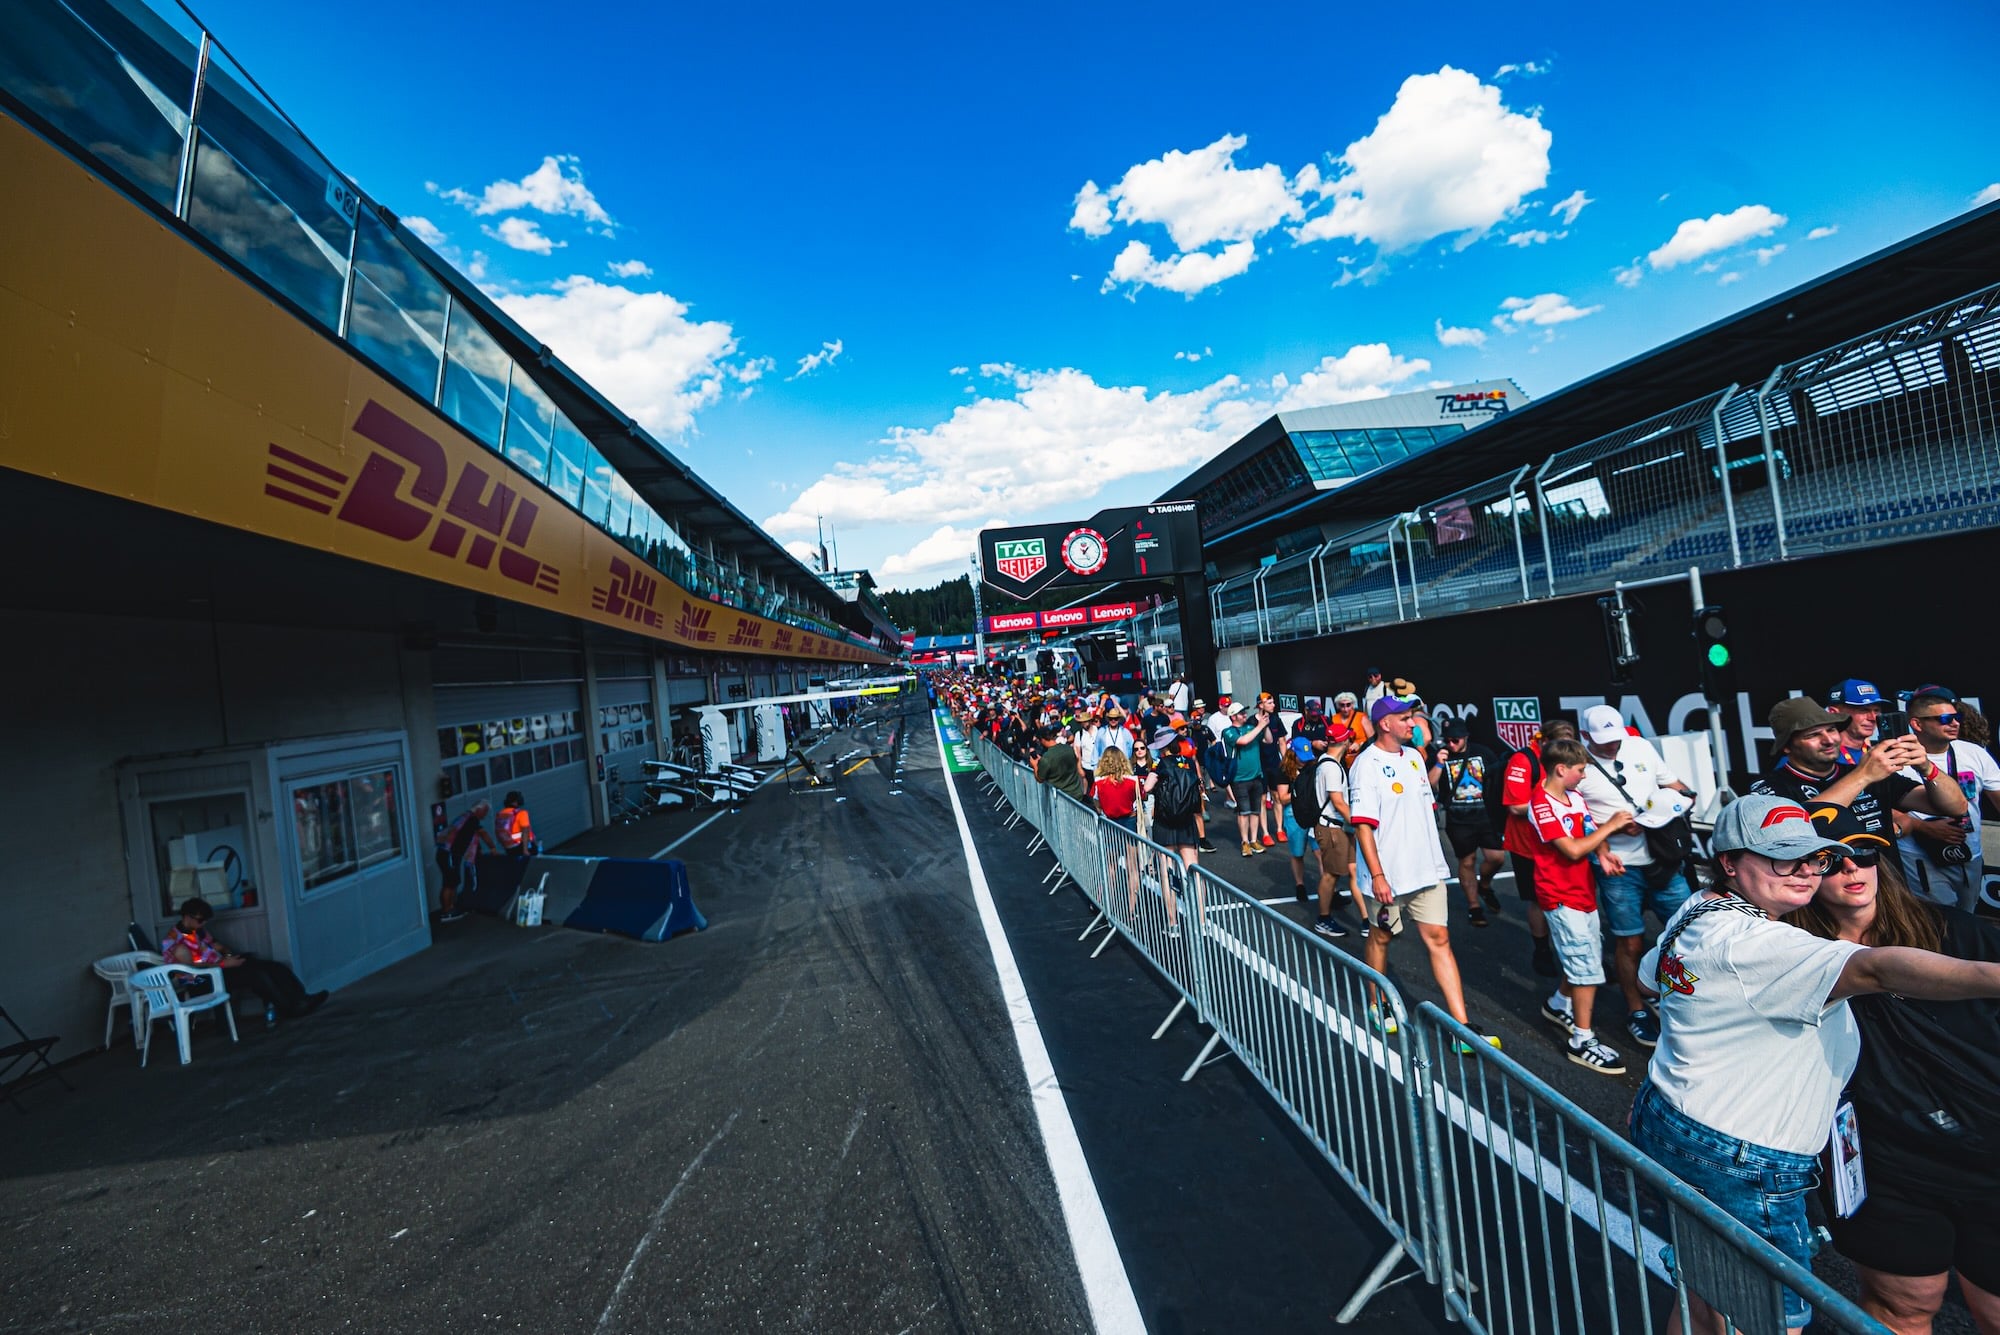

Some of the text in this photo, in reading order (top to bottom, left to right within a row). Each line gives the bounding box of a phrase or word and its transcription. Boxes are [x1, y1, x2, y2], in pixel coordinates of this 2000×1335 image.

[338, 399, 540, 587] DHL
[1000, 542, 1041, 557] TAG
[1000, 558, 1043, 579] HEUER
[605, 556, 657, 627] DHL
[680, 600, 711, 642] DHL
[1044, 612, 1083, 624] Lenovo
[1094, 607, 1132, 619] Lenovo
[993, 617, 1033, 629] Lenovo
[1281, 697, 1296, 709] TAG
[1497, 701, 1536, 719] TAG
